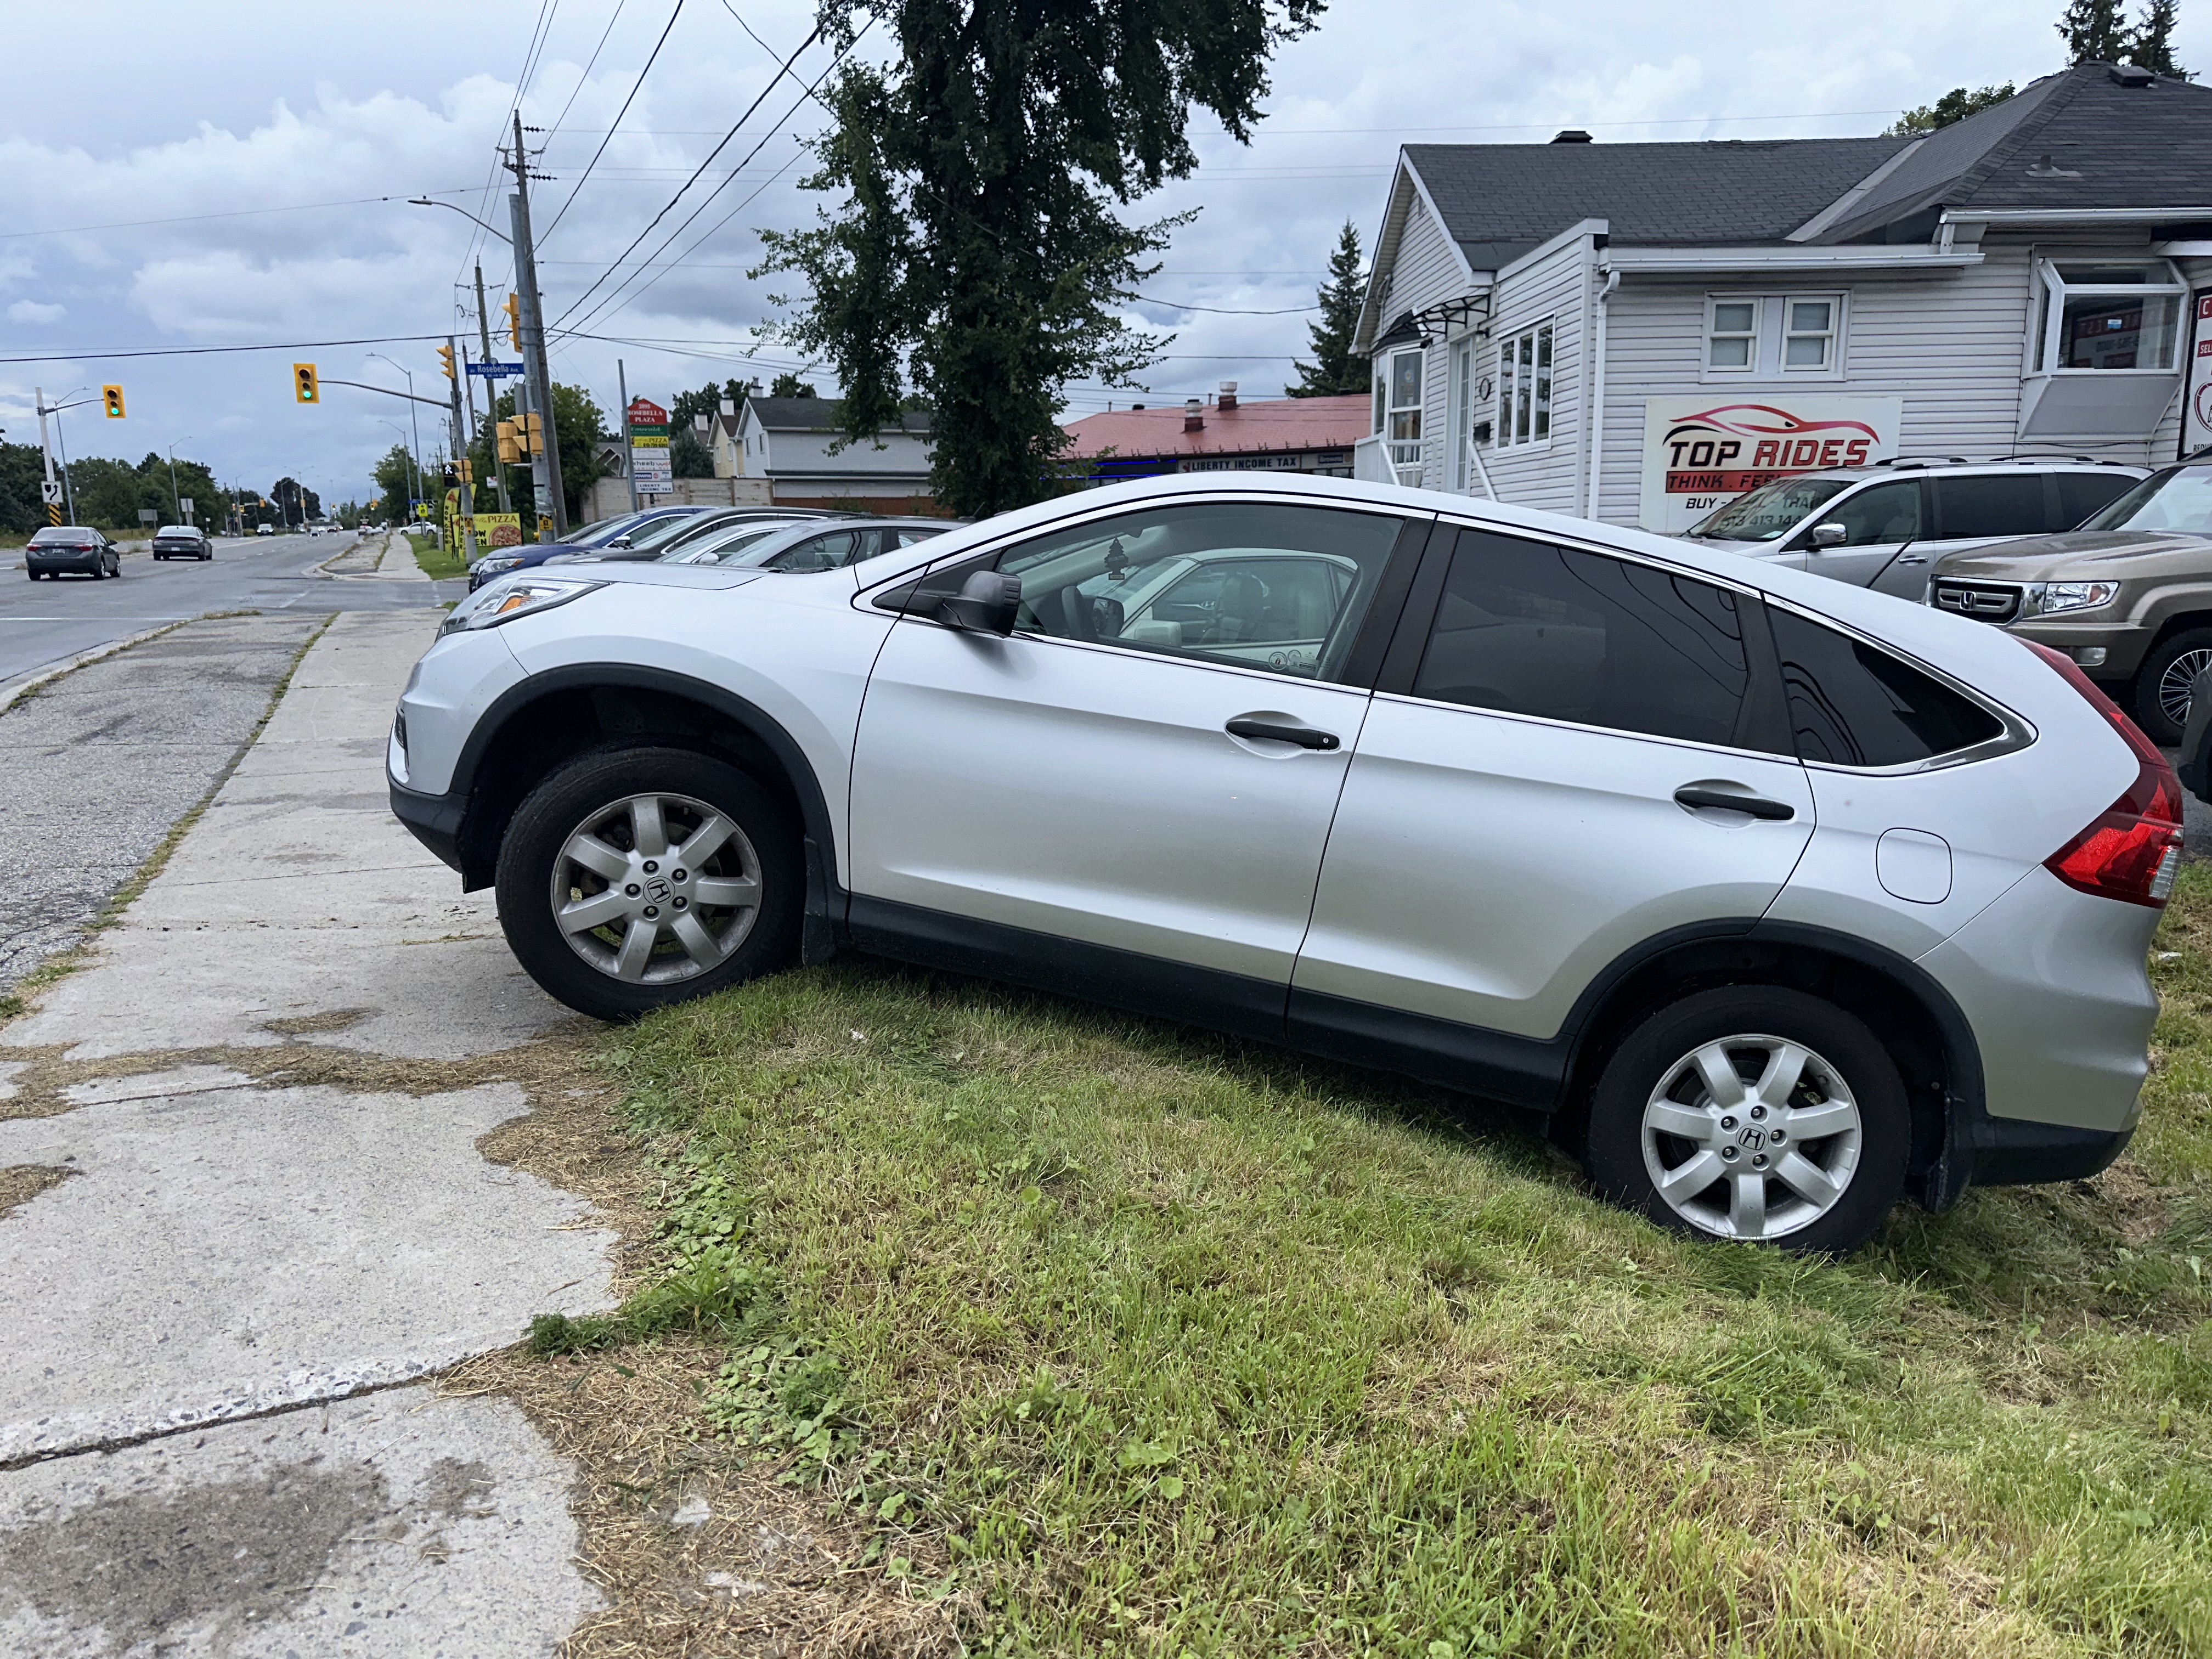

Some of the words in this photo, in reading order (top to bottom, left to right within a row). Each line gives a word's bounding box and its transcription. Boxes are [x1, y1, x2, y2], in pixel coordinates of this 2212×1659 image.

[2200, 343, 2212, 354] SEL
[1669, 441, 1741, 467] TOP
[1753, 439, 1871, 466] RIDES
[1192, 460, 1230, 470] LIBERTY
[1235, 459, 1272, 469] INCOME
[1277, 457, 1296, 466] TAX
[1669, 475, 1723, 488] THINK
[1739, 475, 1781, 488] FEE
[1686, 498, 1717, 509] BUY
